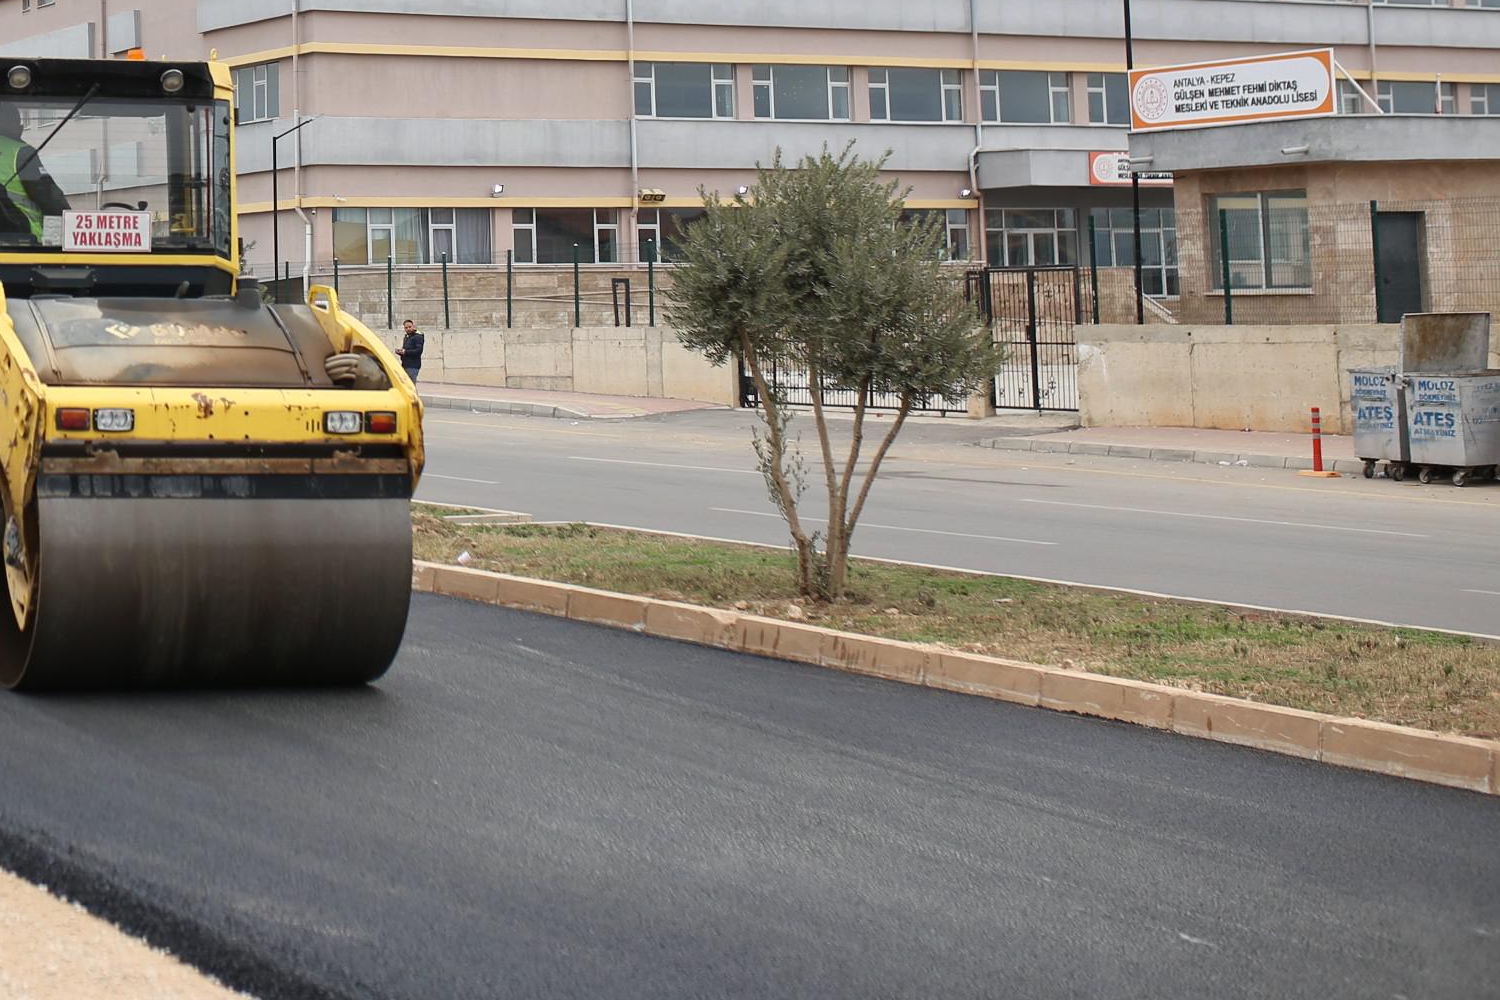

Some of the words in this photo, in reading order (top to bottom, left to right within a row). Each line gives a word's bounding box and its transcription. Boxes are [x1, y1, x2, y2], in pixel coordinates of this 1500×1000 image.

[1173, 76, 1205, 88] ANTALYA
[1210, 73, 1236, 84] KEPEZ
[1174, 88, 1205, 101] GÜLŞEN
[1208, 85, 1241, 98] MEHMET
[1243, 81, 1267, 94] FEHMİ
[1268, 79, 1298, 92] DİKTAŞ
[1174, 101, 1208, 113] MESLEKİ
[1209, 101, 1219, 111] VE
[1221, 96, 1249, 109] TEKNİK
[1250, 94, 1290, 106] ANADOLU
[1291, 89, 1318, 104] LİSESİ
[76, 215, 93, 229] 25
[96, 215, 139, 229] METRE
[72, 232, 142, 248] YAKLAŞMA
[1418, 380, 1455, 391] MOLOZ
[1357, 405, 1393, 421] ATEŞ
[1413, 411, 1455, 428] ATEŞ
